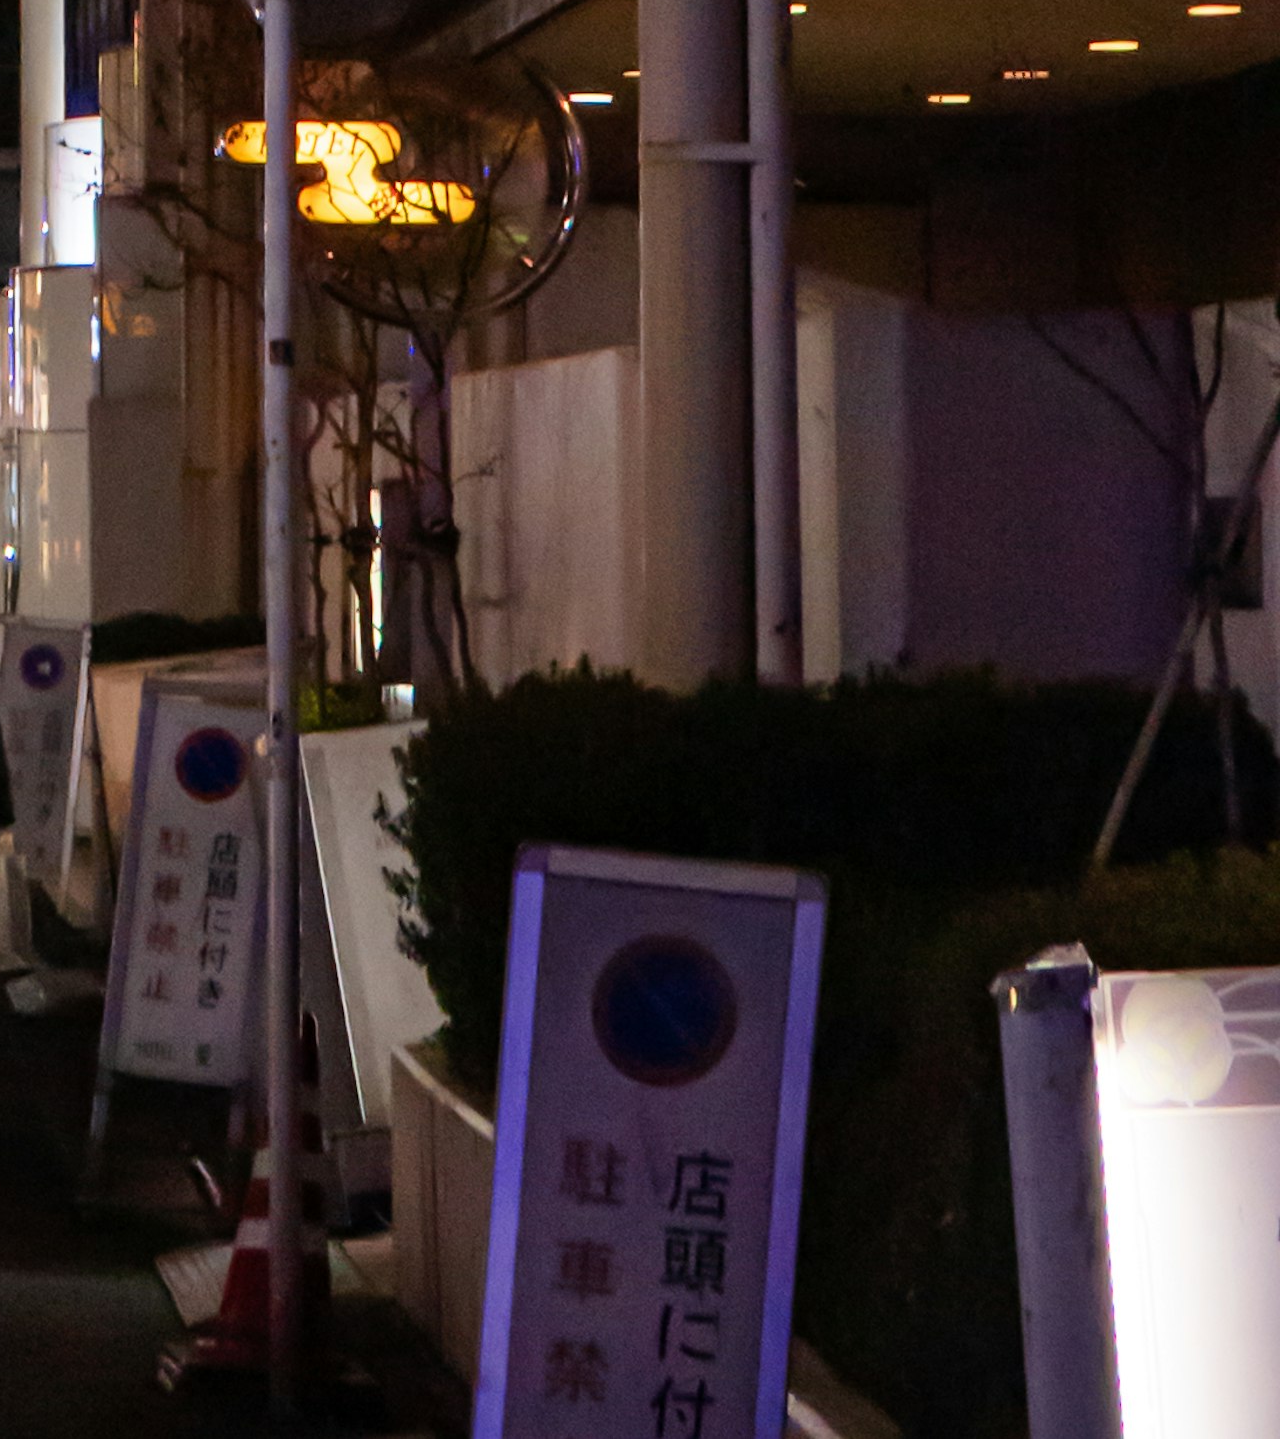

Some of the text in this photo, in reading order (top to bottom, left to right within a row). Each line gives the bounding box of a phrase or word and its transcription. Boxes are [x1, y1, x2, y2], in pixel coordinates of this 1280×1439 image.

[198, 831, 243, 1009] 店頭に付き
[545, 1139, 627, 1404] 駐車禁
[650, 1149, 733, 1439] 店頭に付
